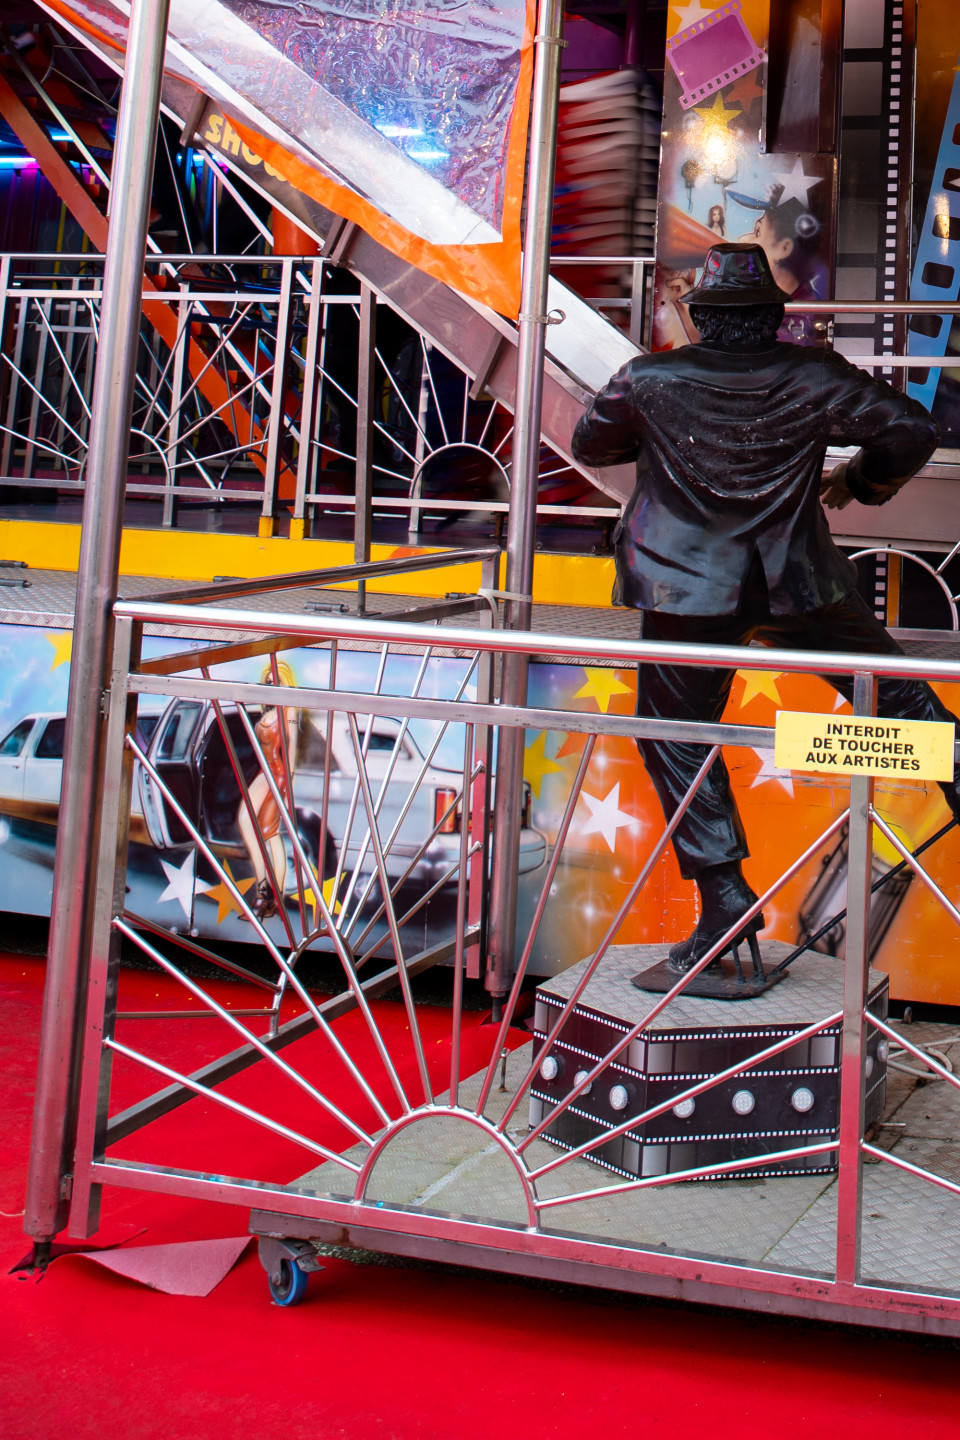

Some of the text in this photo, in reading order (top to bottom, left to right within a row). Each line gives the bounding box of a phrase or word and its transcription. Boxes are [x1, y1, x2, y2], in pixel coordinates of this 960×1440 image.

[827, 723, 901, 739] INTERDIT
[812, 737, 914, 755] DE TOUCHER
[805, 752, 920, 771] AUX ARTISTES
